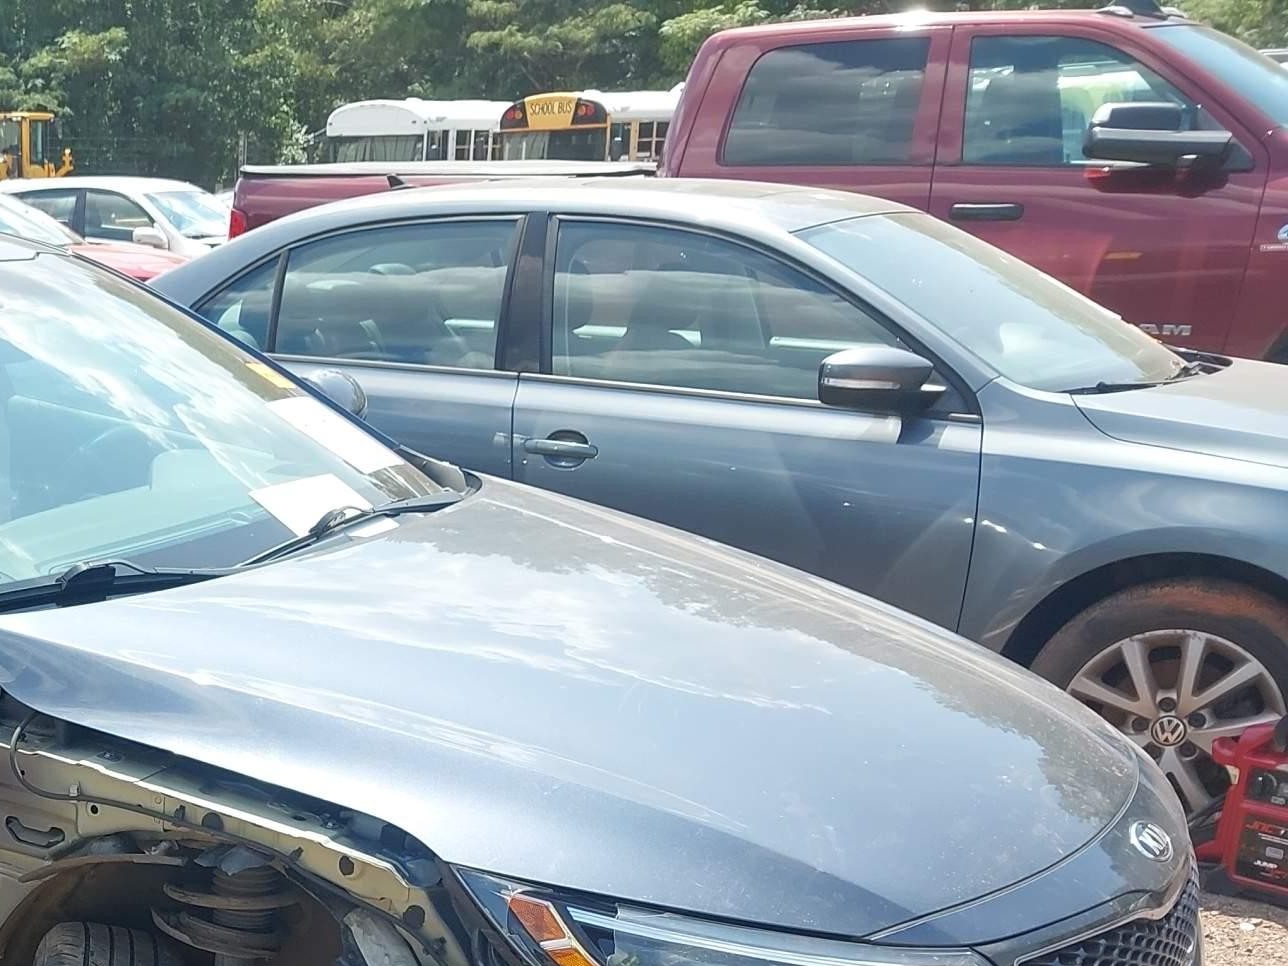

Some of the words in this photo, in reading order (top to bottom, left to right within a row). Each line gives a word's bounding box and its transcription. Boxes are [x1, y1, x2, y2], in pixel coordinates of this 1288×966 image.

[530, 102, 555, 115] SCHOOL
[558, 101, 572, 114] BUS
[1139, 323, 1192, 336] AM
